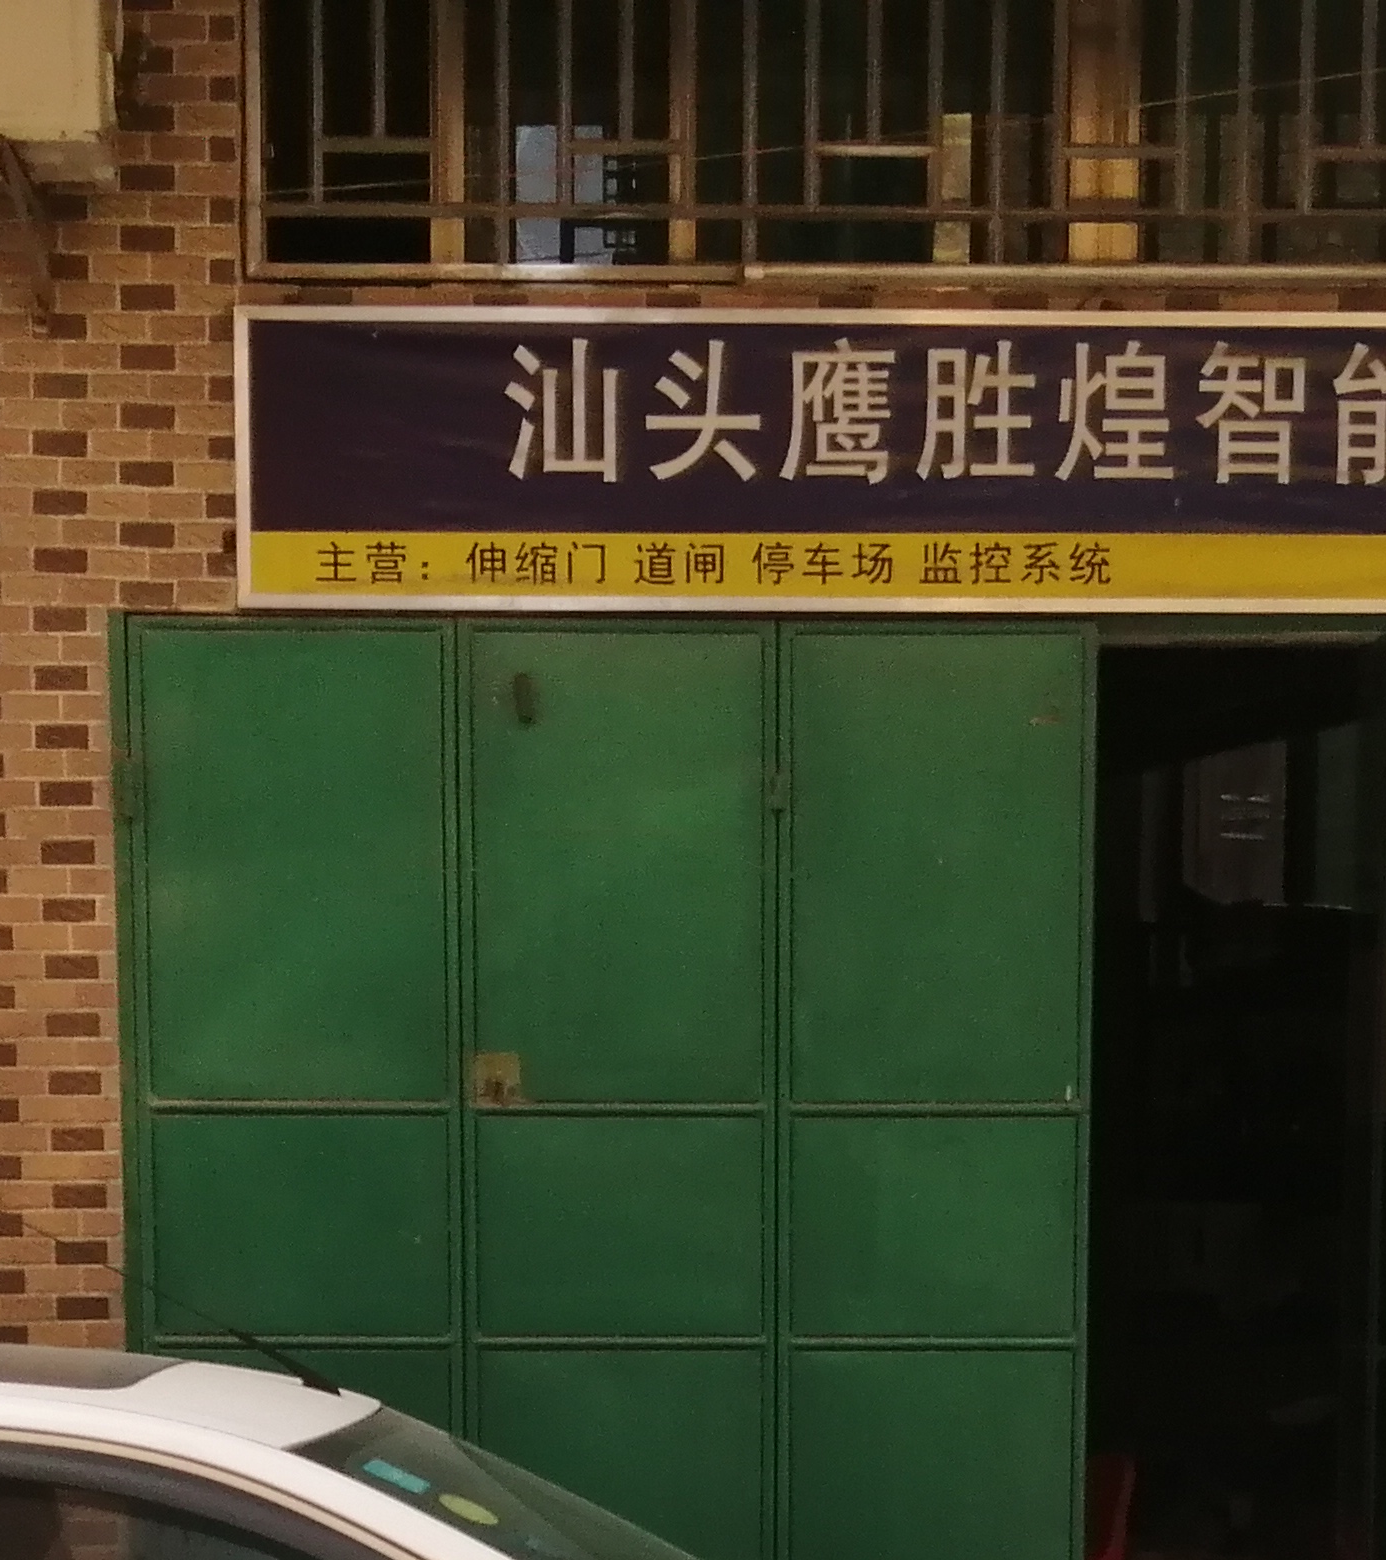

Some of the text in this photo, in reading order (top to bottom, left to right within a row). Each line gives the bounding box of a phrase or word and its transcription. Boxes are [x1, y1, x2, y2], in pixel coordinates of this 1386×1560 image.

[634, 541, 725, 587] 道闸
[751, 541, 894, 587] 停车场
[920, 541, 1113, 587] 监控系统
